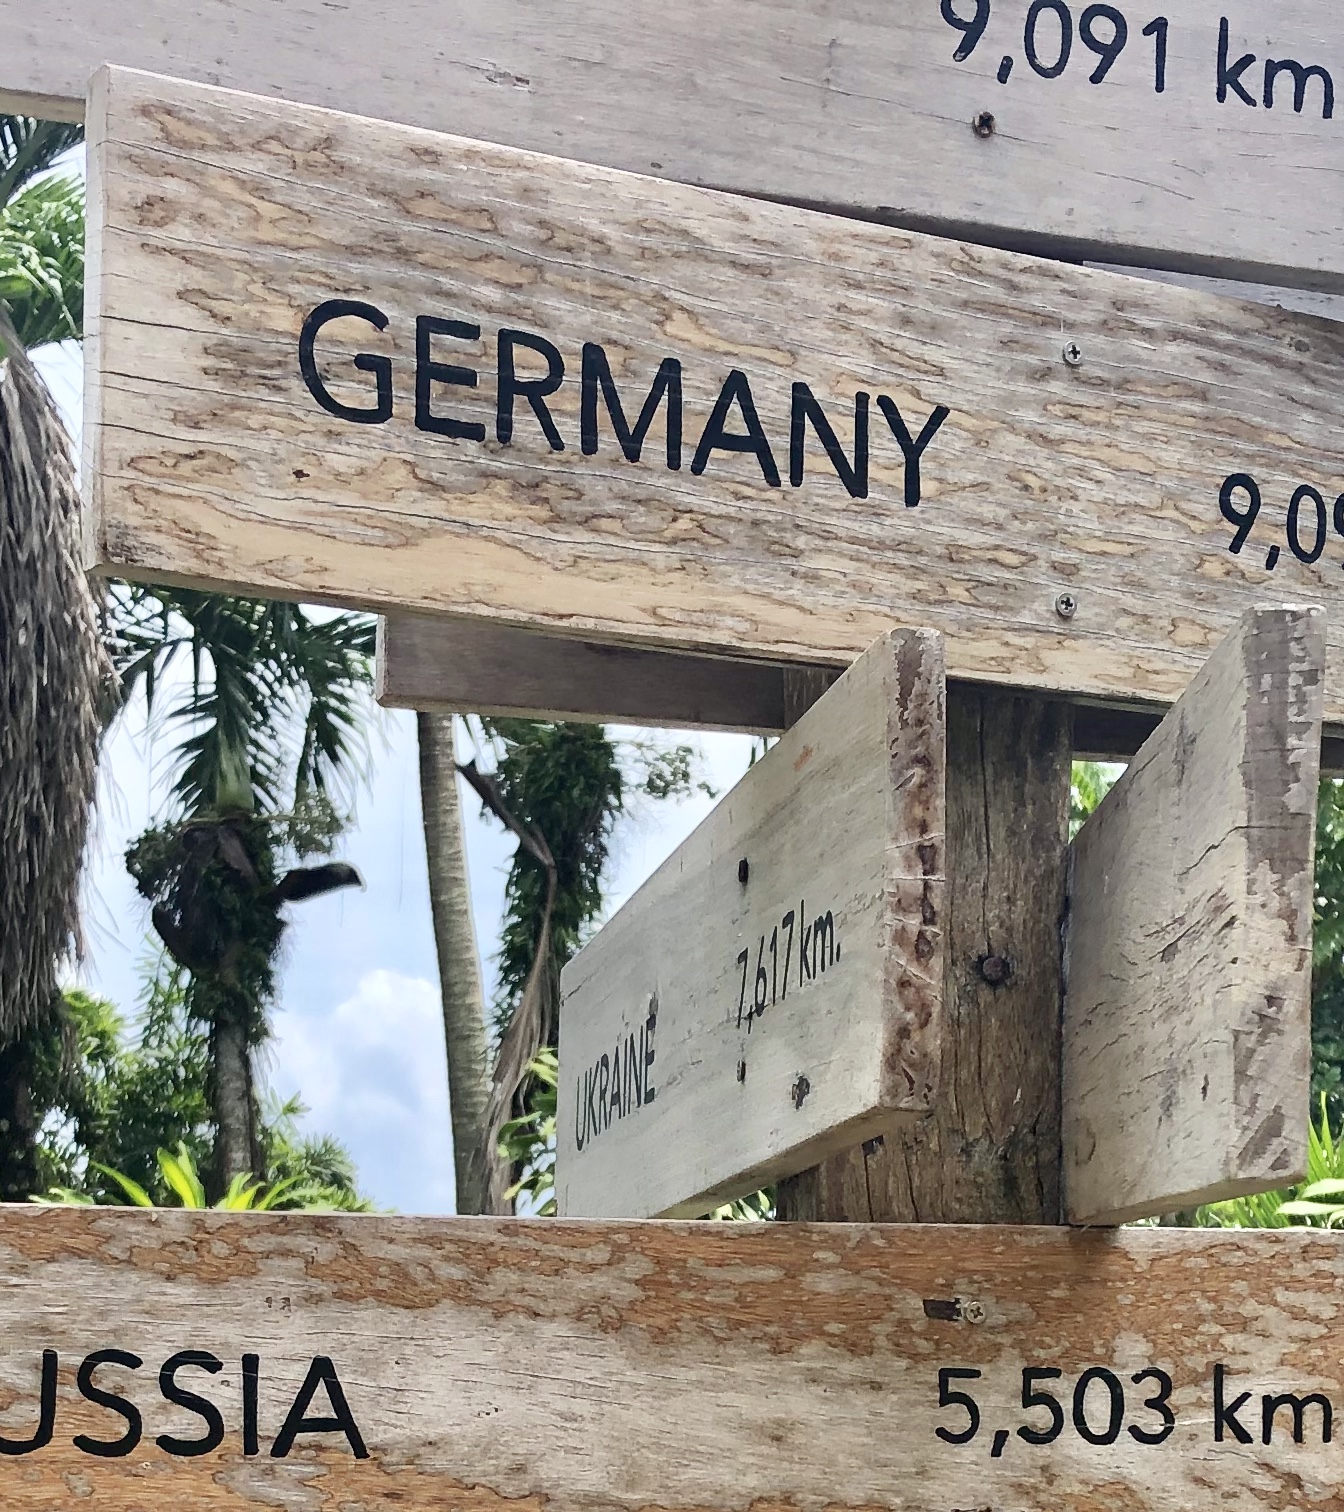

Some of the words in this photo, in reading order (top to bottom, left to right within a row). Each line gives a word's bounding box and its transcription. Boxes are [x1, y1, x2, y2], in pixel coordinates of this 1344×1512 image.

[940, 0, 1169, 94] 9,091
[297, 299, 950, 508] GERMANY
[574, 1010, 657, 1152] UKRAINE
[737, 909, 795, 1035] 7,617
[799, 898, 842, 988] km.
[934, 1365, 1176, 1458] 5,503
